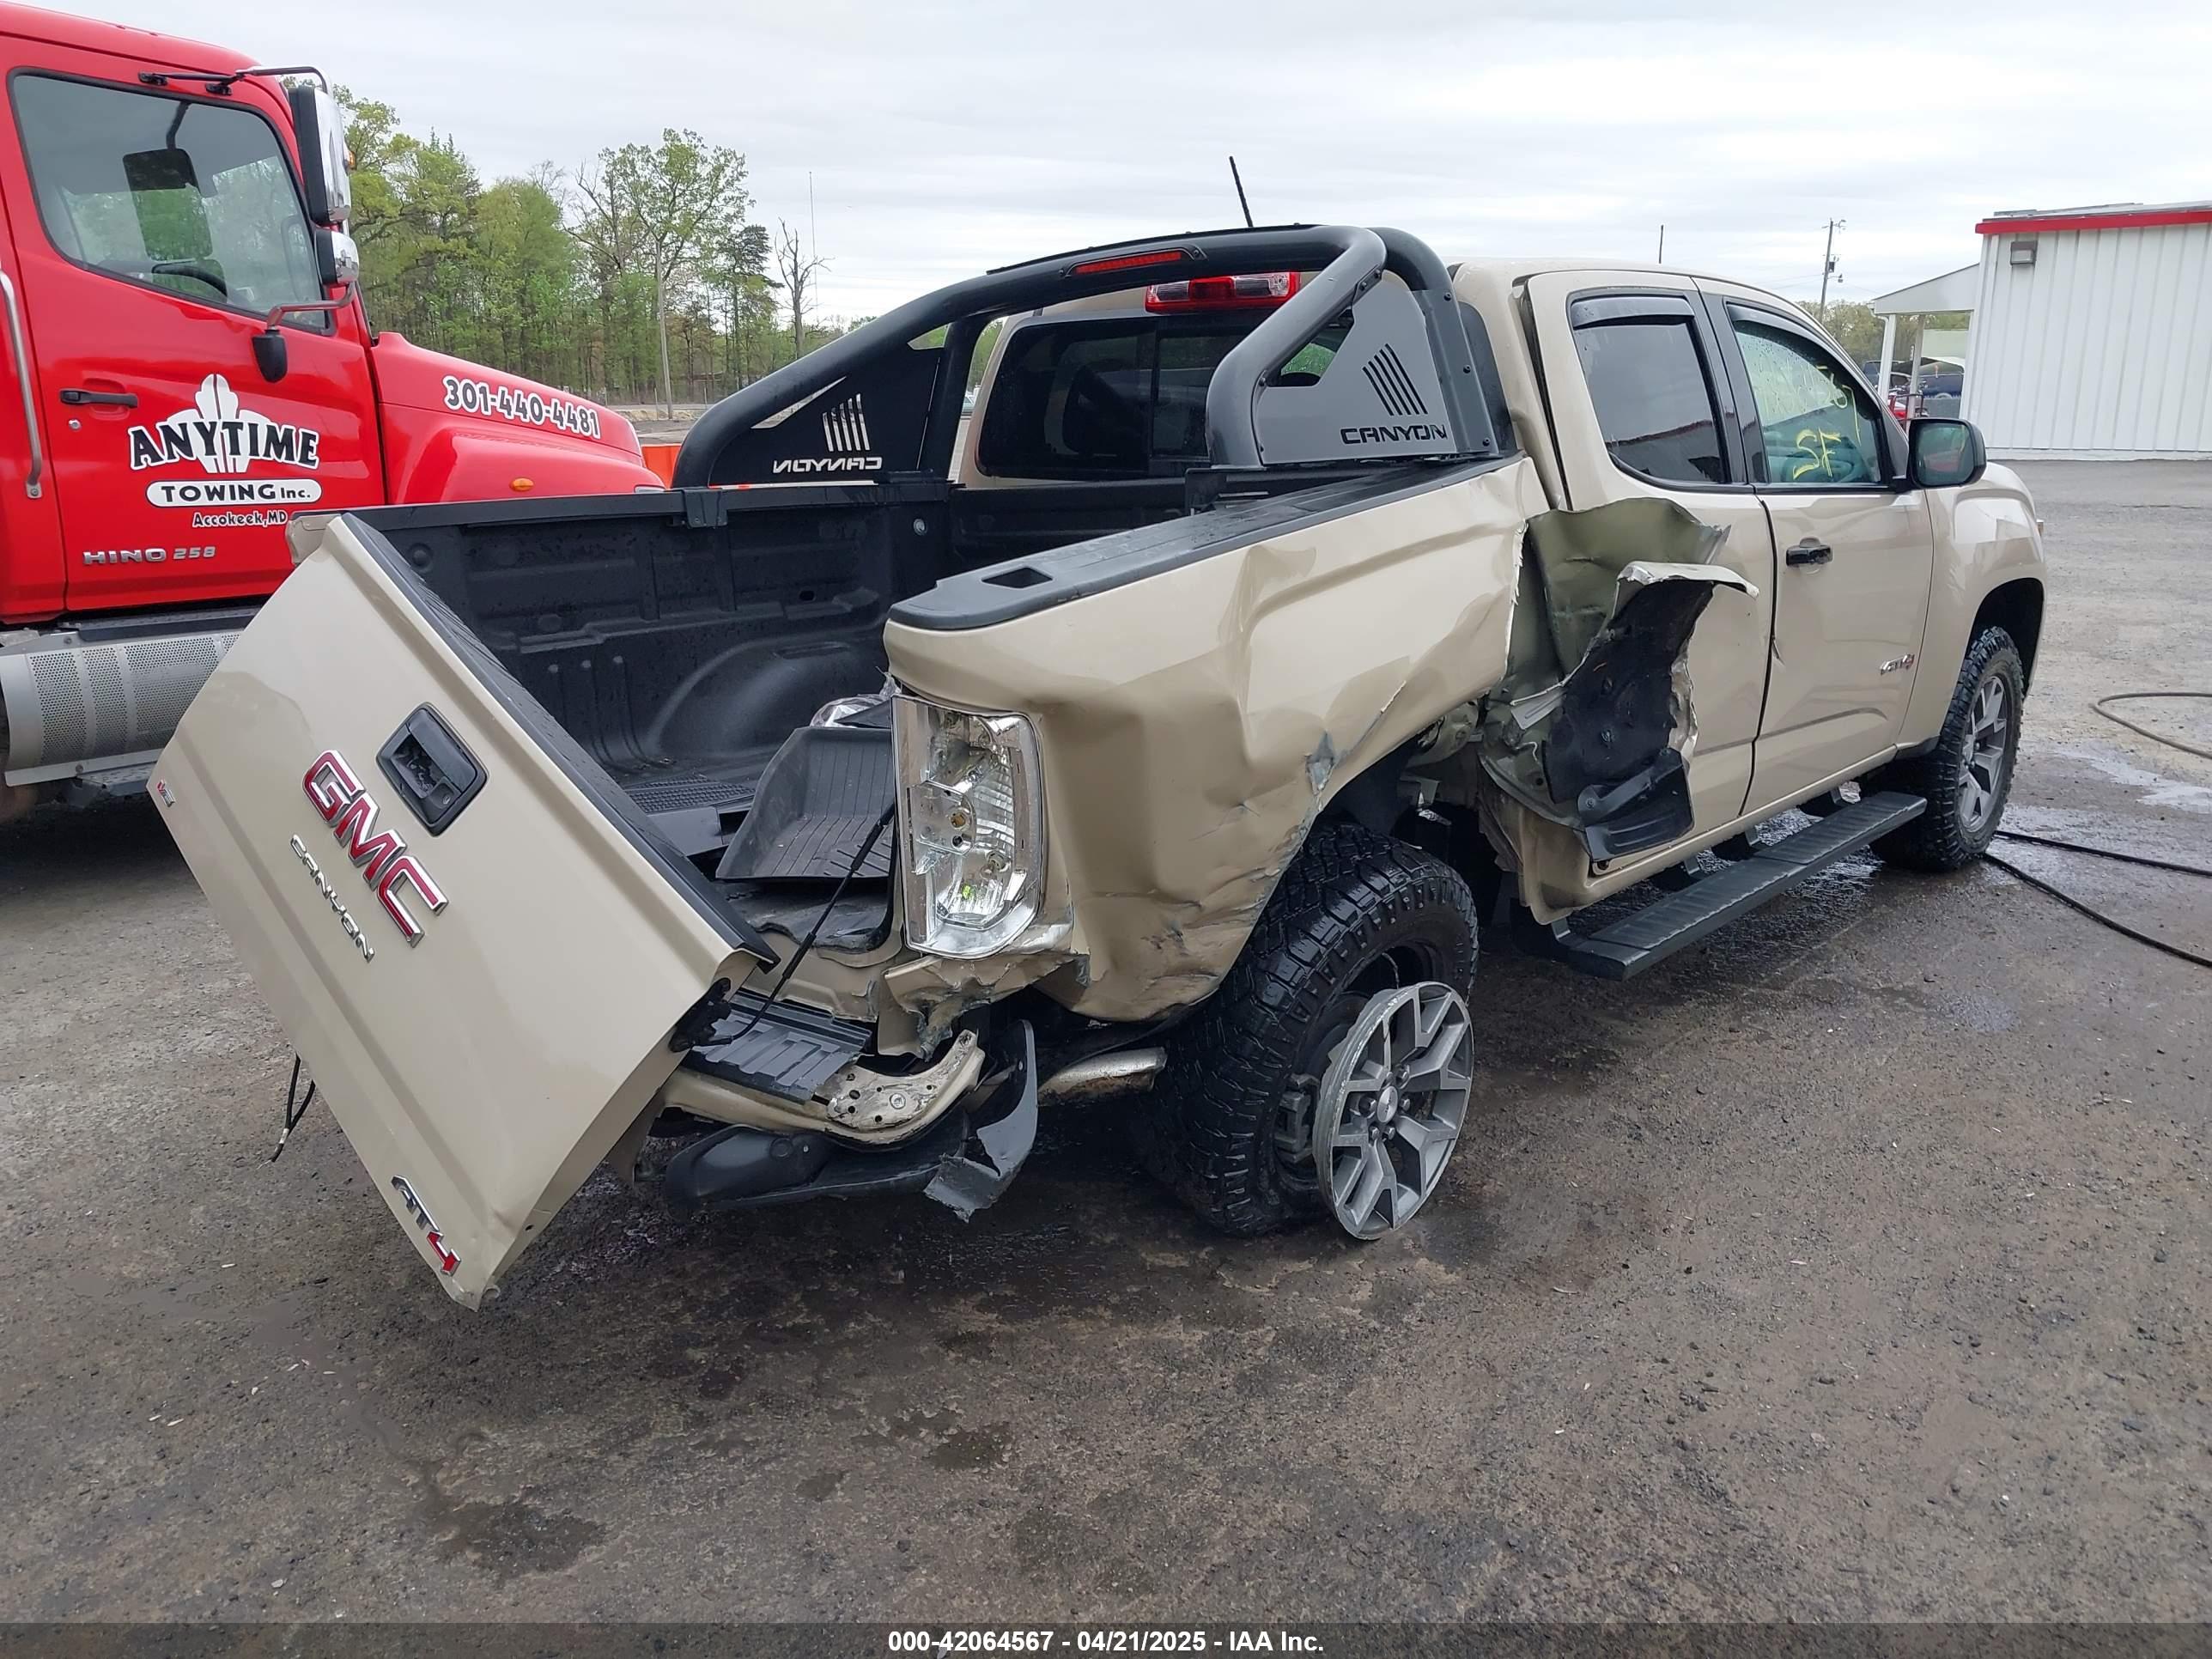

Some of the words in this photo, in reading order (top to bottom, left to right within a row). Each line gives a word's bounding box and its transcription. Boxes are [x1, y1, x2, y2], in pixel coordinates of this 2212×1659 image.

[445, 378, 600, 437] 301-440-4481
[1340, 424, 1448, 445] CANYON
[130, 420, 319, 469] ANYTIME
[161, 483, 276, 502] TOWING
[281, 487, 311, 499] Inc.
[83, 548, 167, 564] HINO
[173, 546, 216, 560] 258
[302, 750, 449, 949] GMC
[290, 834, 375, 963] CANYON
[391, 1175, 461, 1277] AT4
